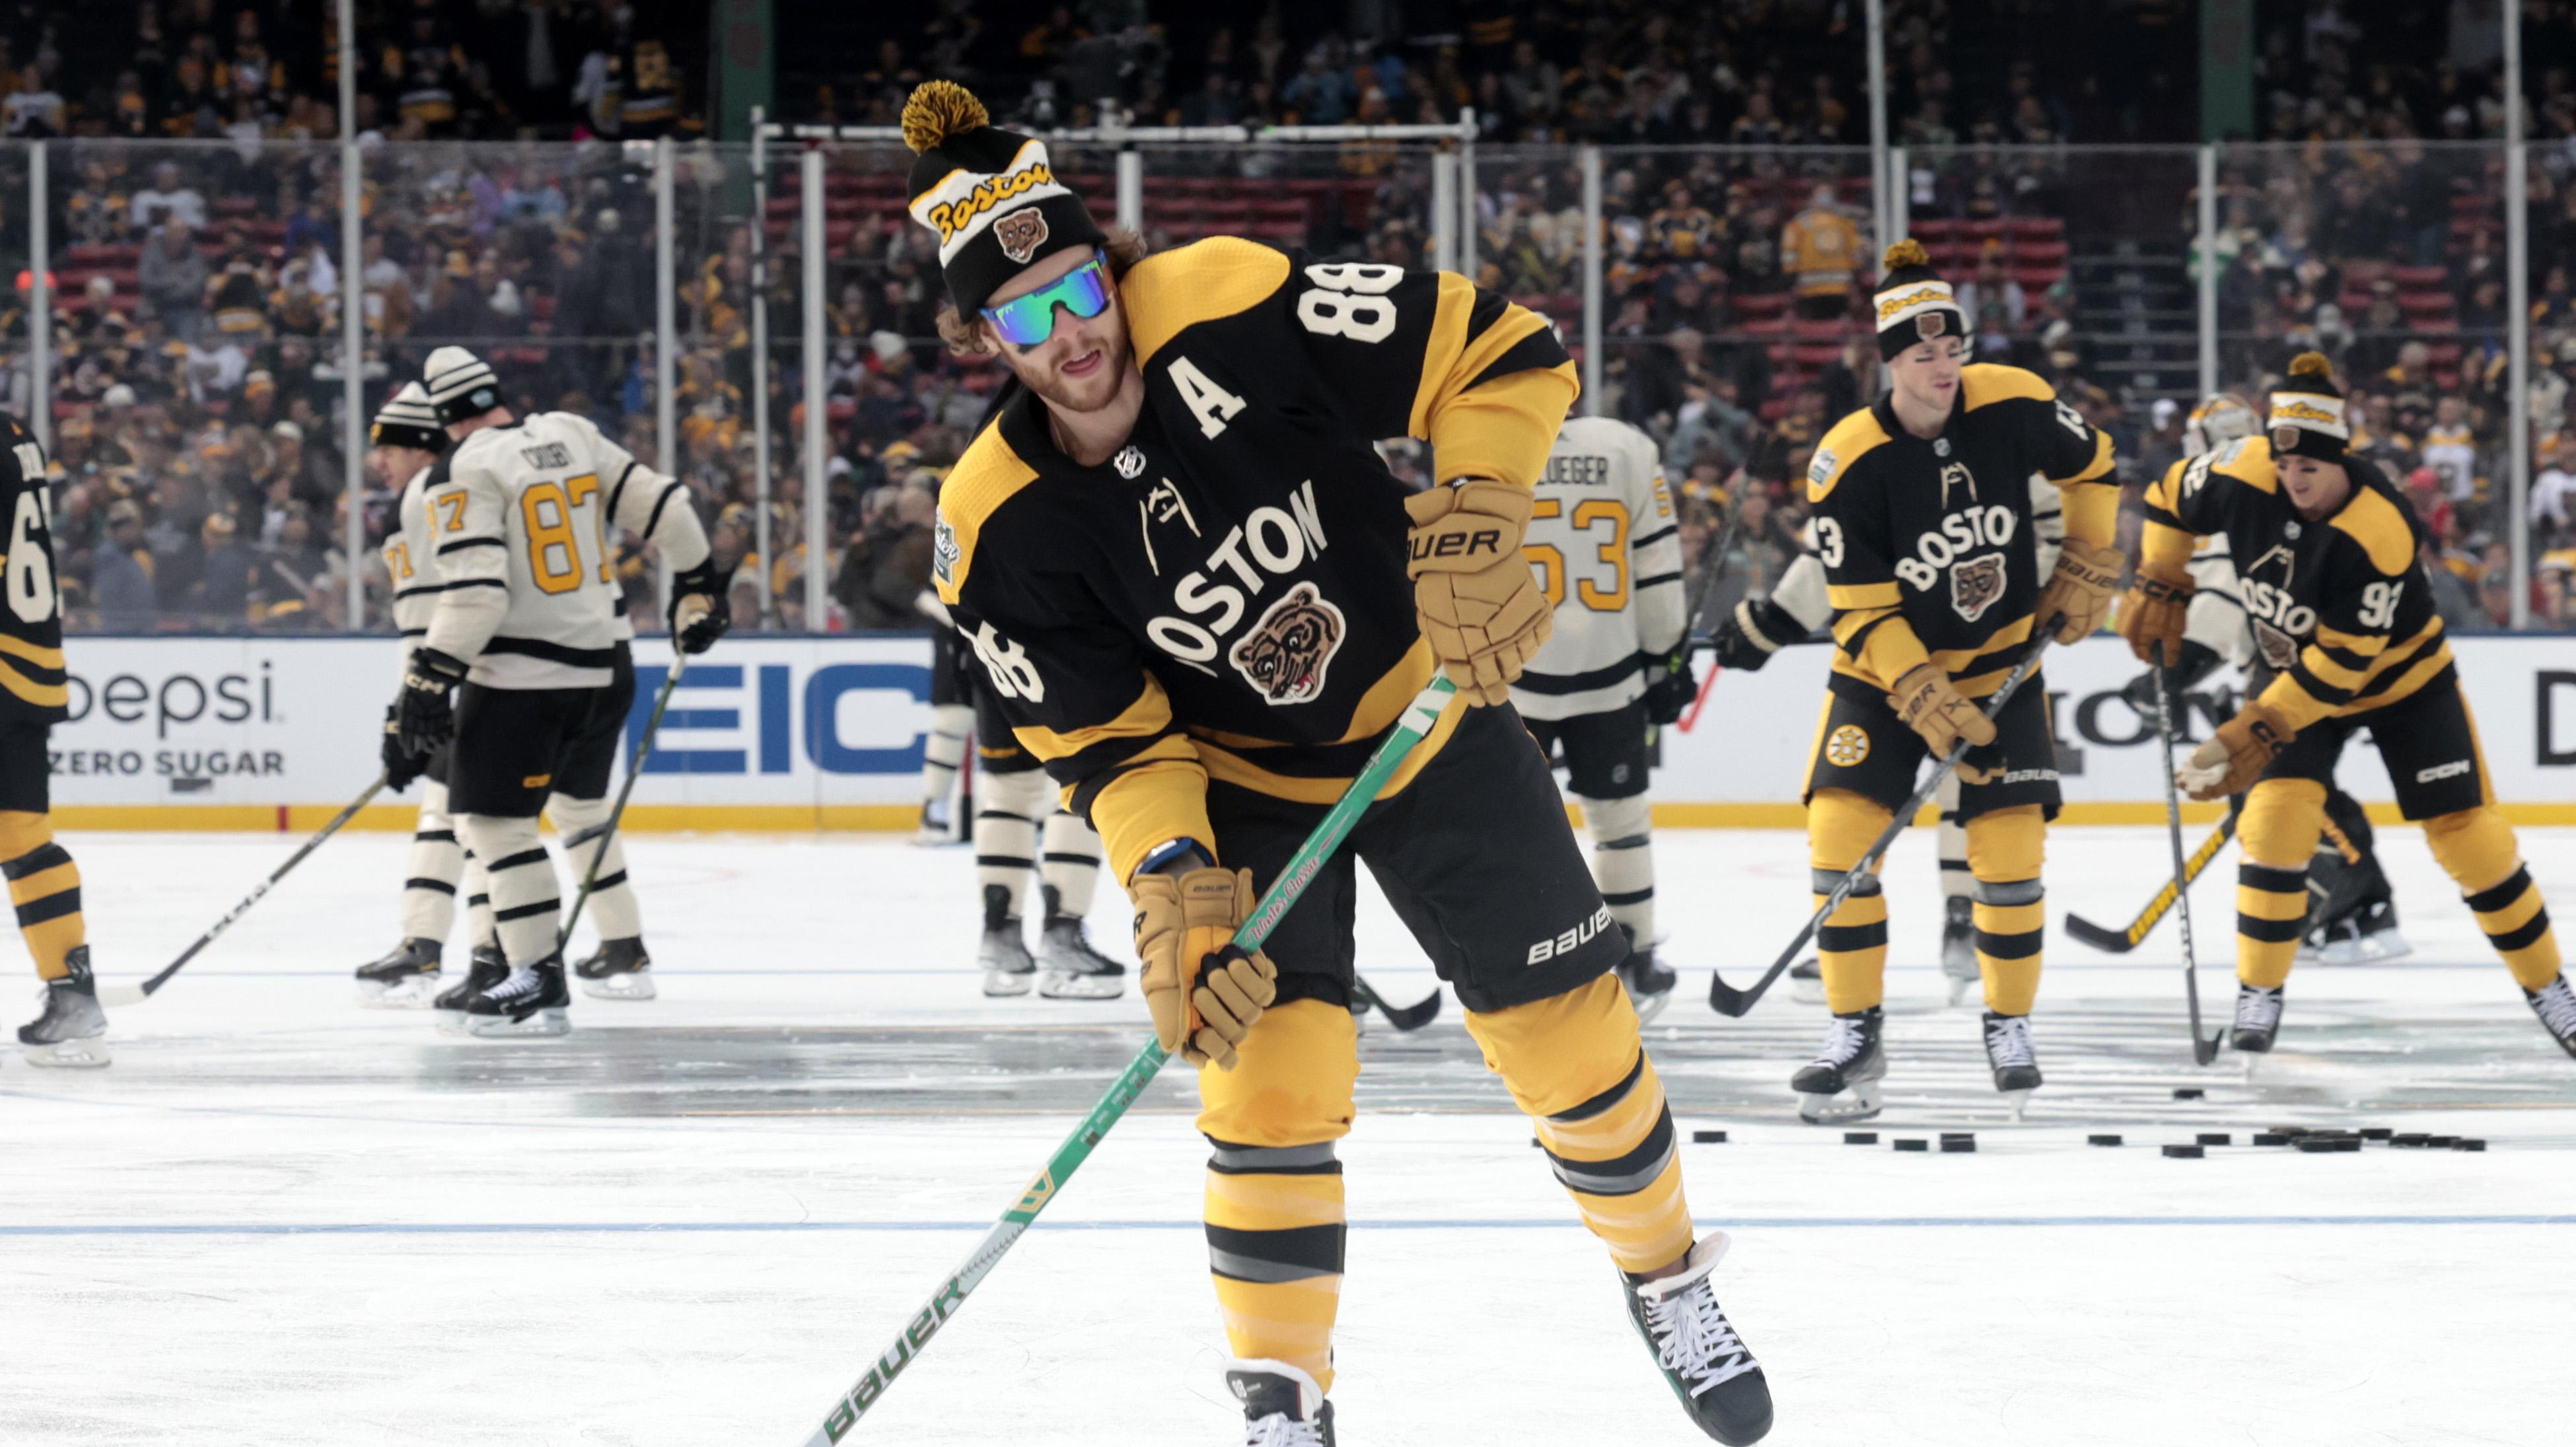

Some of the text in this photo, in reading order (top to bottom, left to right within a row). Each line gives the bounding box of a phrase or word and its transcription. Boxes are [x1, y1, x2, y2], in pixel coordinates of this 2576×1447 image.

[928, 163, 1056, 248] Boston
[1297, 262, 1404, 343] 88
[1167, 355, 1247, 441] A
[1537, 456, 1608, 485] UEGER
[7, 486, 63, 623] 6
[1147, 478, 1328, 678] OSTON
[1408, 530, 1501, 561] UER
[1522, 498, 1631, 612] 53
[1894, 505, 2019, 592] BOSTO
[2238, 576, 2317, 635] OSTO
[626, 664, 934, 775] EIC
[50, 752, 284, 777] ZERO SUGAR
[1246, 855, 1320, 944] Winter Classic
